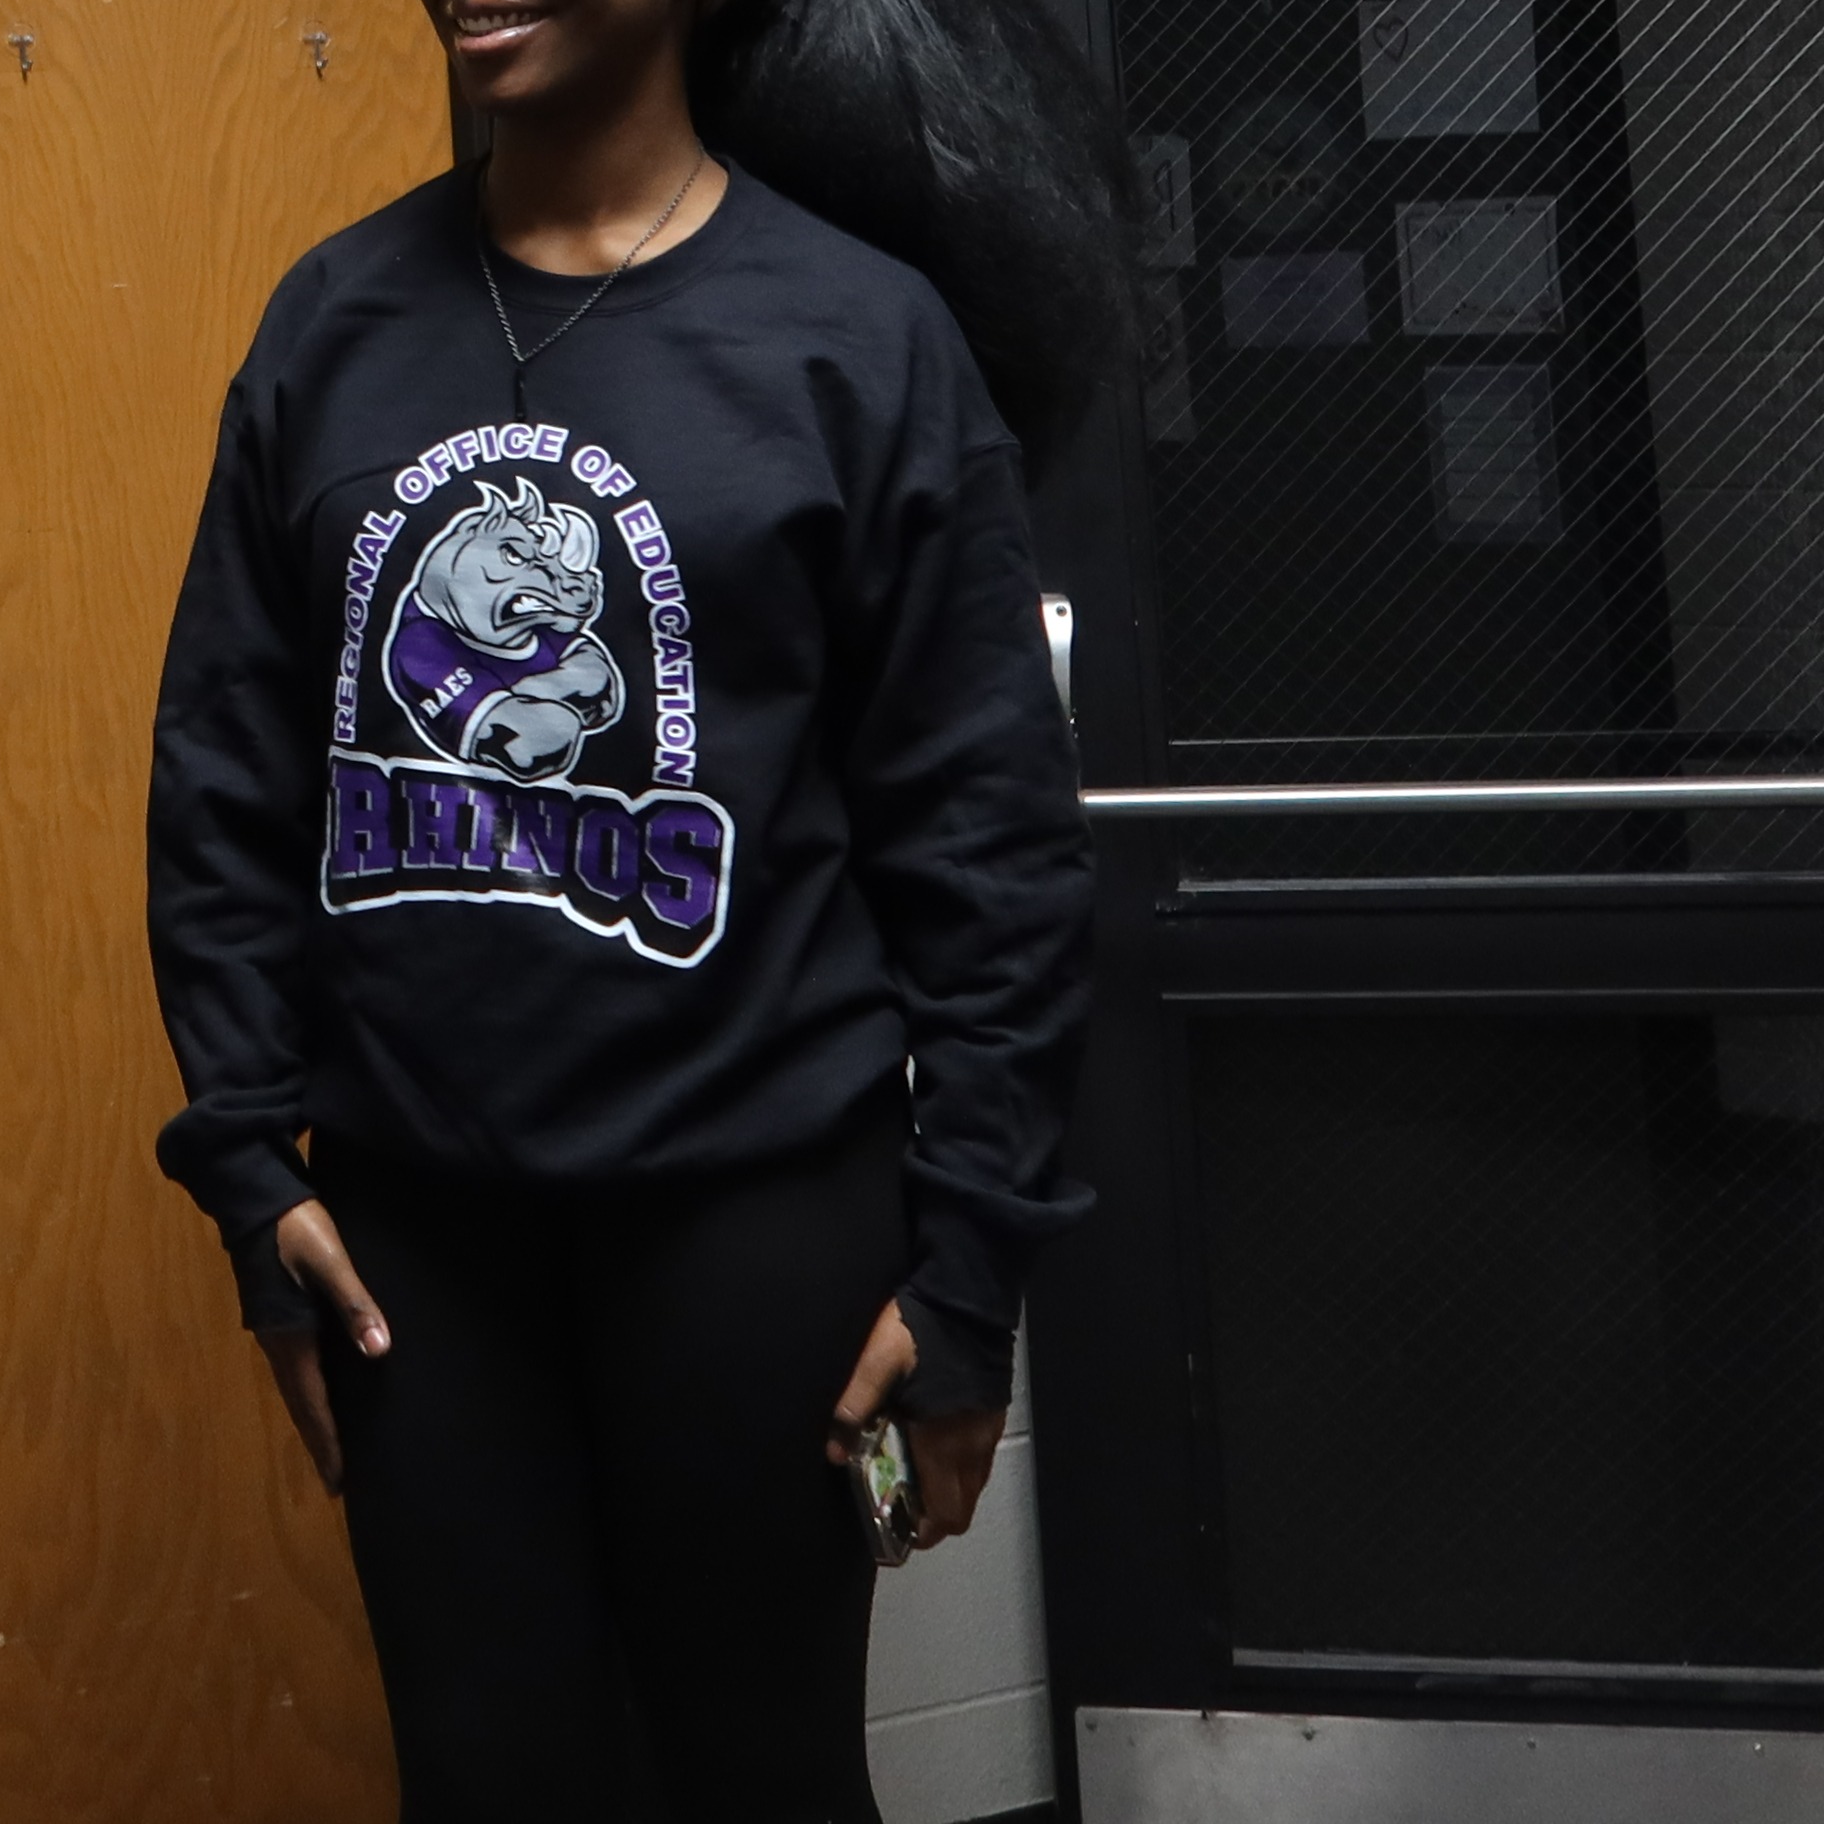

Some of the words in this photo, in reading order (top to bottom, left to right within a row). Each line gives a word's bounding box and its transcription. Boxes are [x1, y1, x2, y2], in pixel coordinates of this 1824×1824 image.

[335, 509, 406, 743] REGIONAL
[395, 423, 568, 504] OFFICE
[571, 446, 637, 498] OF
[615, 501, 697, 788] EDUCATION
[420, 666, 474, 720] RAES
[331, 762, 722, 932] RHINOS
